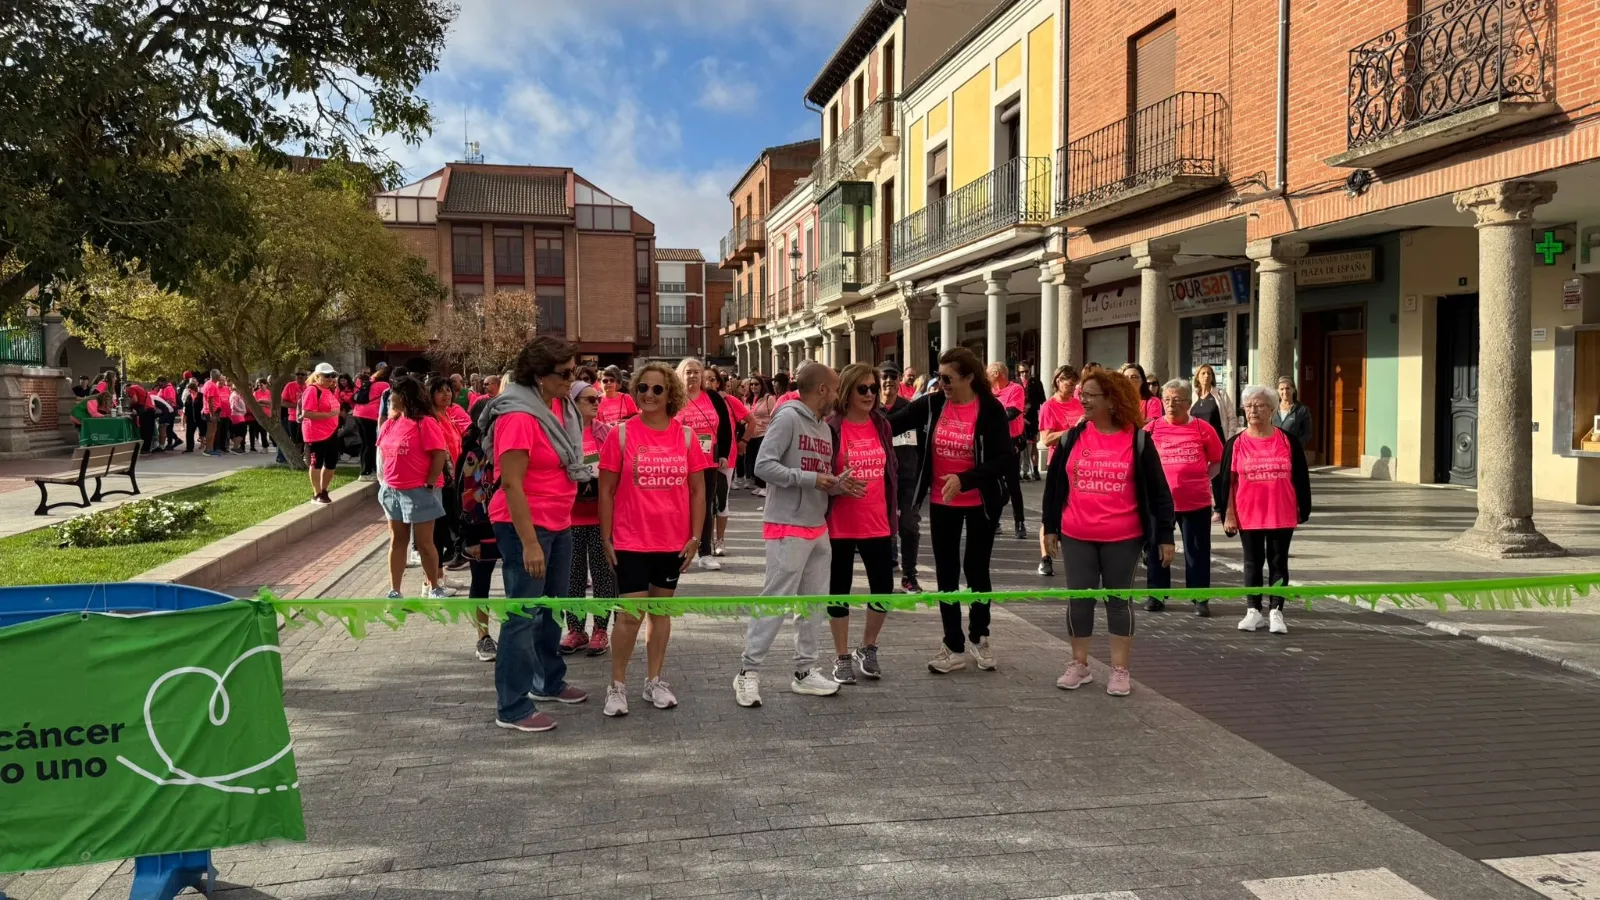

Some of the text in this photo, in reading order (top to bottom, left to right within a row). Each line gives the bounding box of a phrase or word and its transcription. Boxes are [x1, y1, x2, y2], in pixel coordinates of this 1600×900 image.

[1301, 261, 1366, 277] PLAZA DE ESPAÑA
[1084, 294, 1137, 314] José Gutiérrez
[937, 427, 974, 440] En marc
[638, 454, 650, 462] En
[848, 449, 858, 457] En
[848, 458, 881, 467] contra
[1078, 459, 1129, 469] En marcha
[1244, 463, 1280, 471] contra
[637, 464, 678, 473] contra
[849, 467, 885, 478] cánce
[1078, 469, 1127, 480] contra el
[1247, 470, 1288, 480] cáncer
[1078, 478, 1127, 493] cáncer
[0, 722, 126, 752] cáncer
[36, 757, 107, 782] uno
